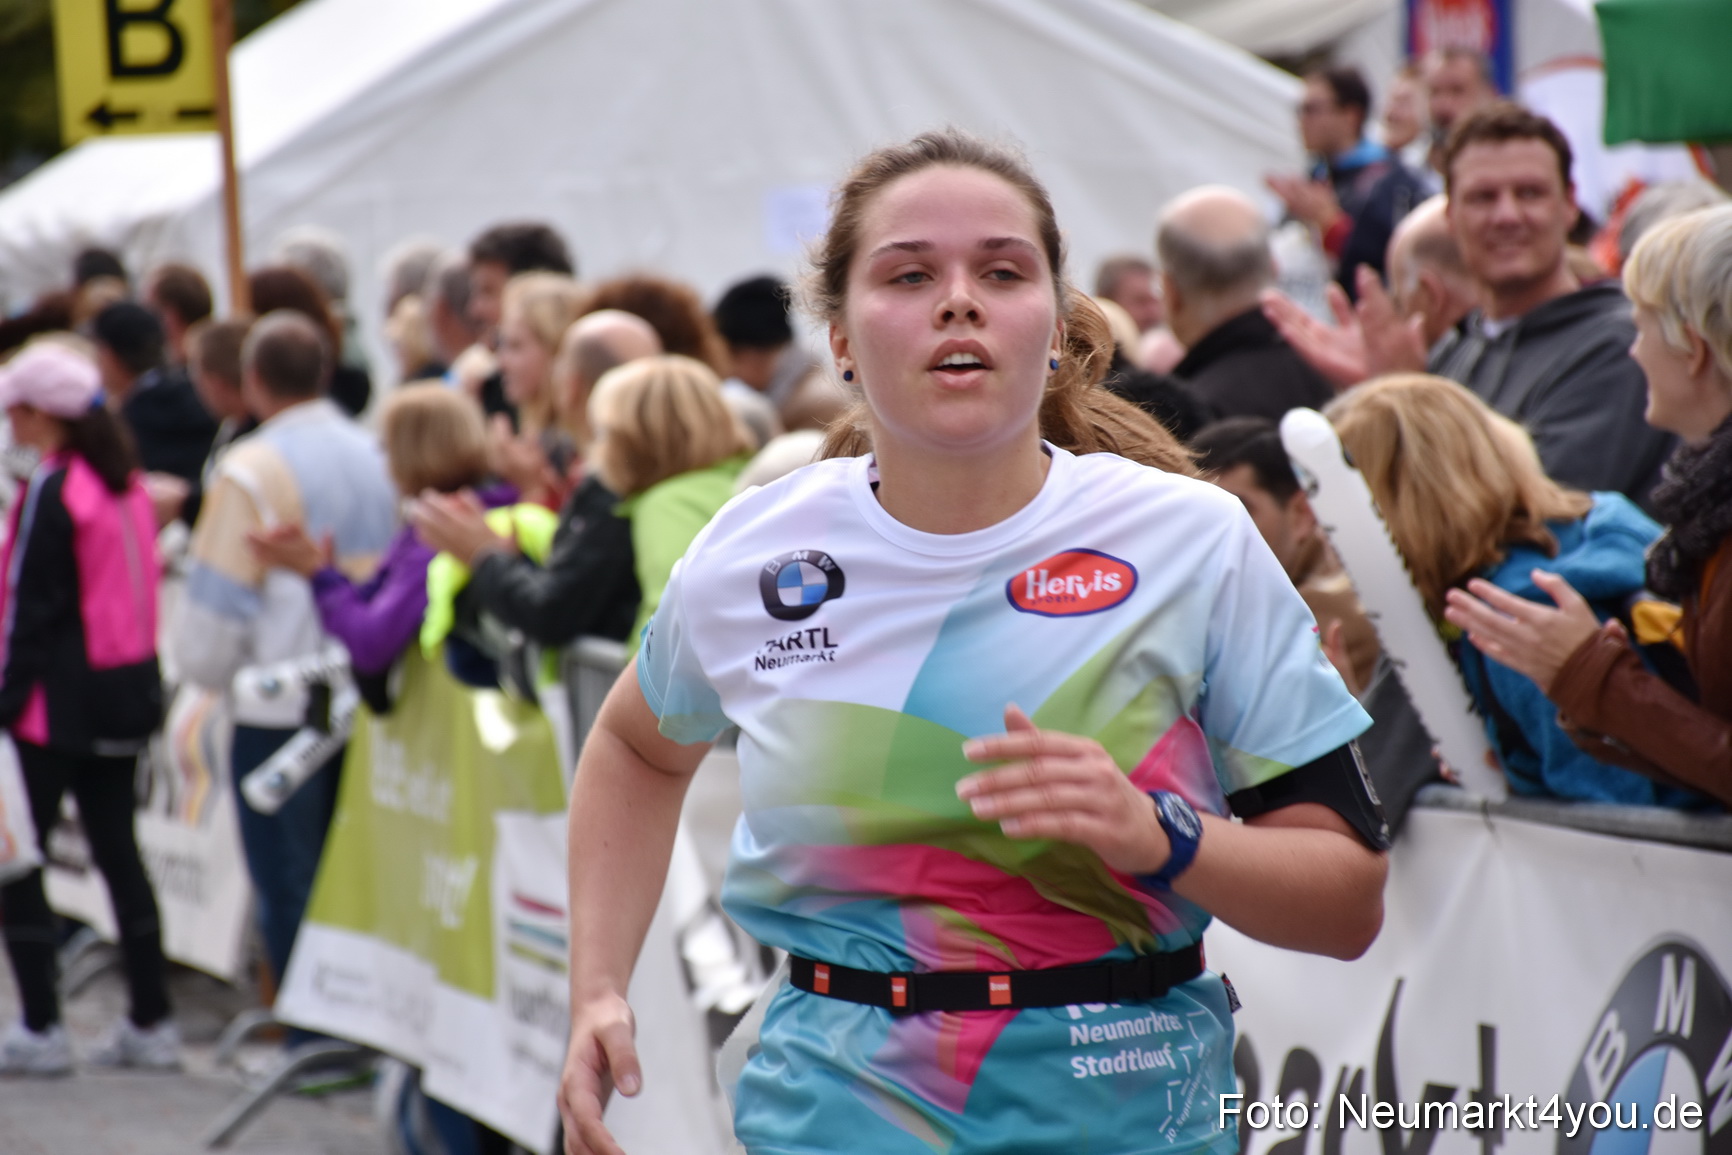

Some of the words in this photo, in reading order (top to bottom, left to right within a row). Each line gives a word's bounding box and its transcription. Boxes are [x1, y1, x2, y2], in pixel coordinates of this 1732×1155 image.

[105, 0, 184, 79] B
[1025, 568, 1122, 600] Hervis
[1069, 1011, 1184, 1046] Neumarkter
[1071, 1042, 1177, 1079] Stadtlauf
